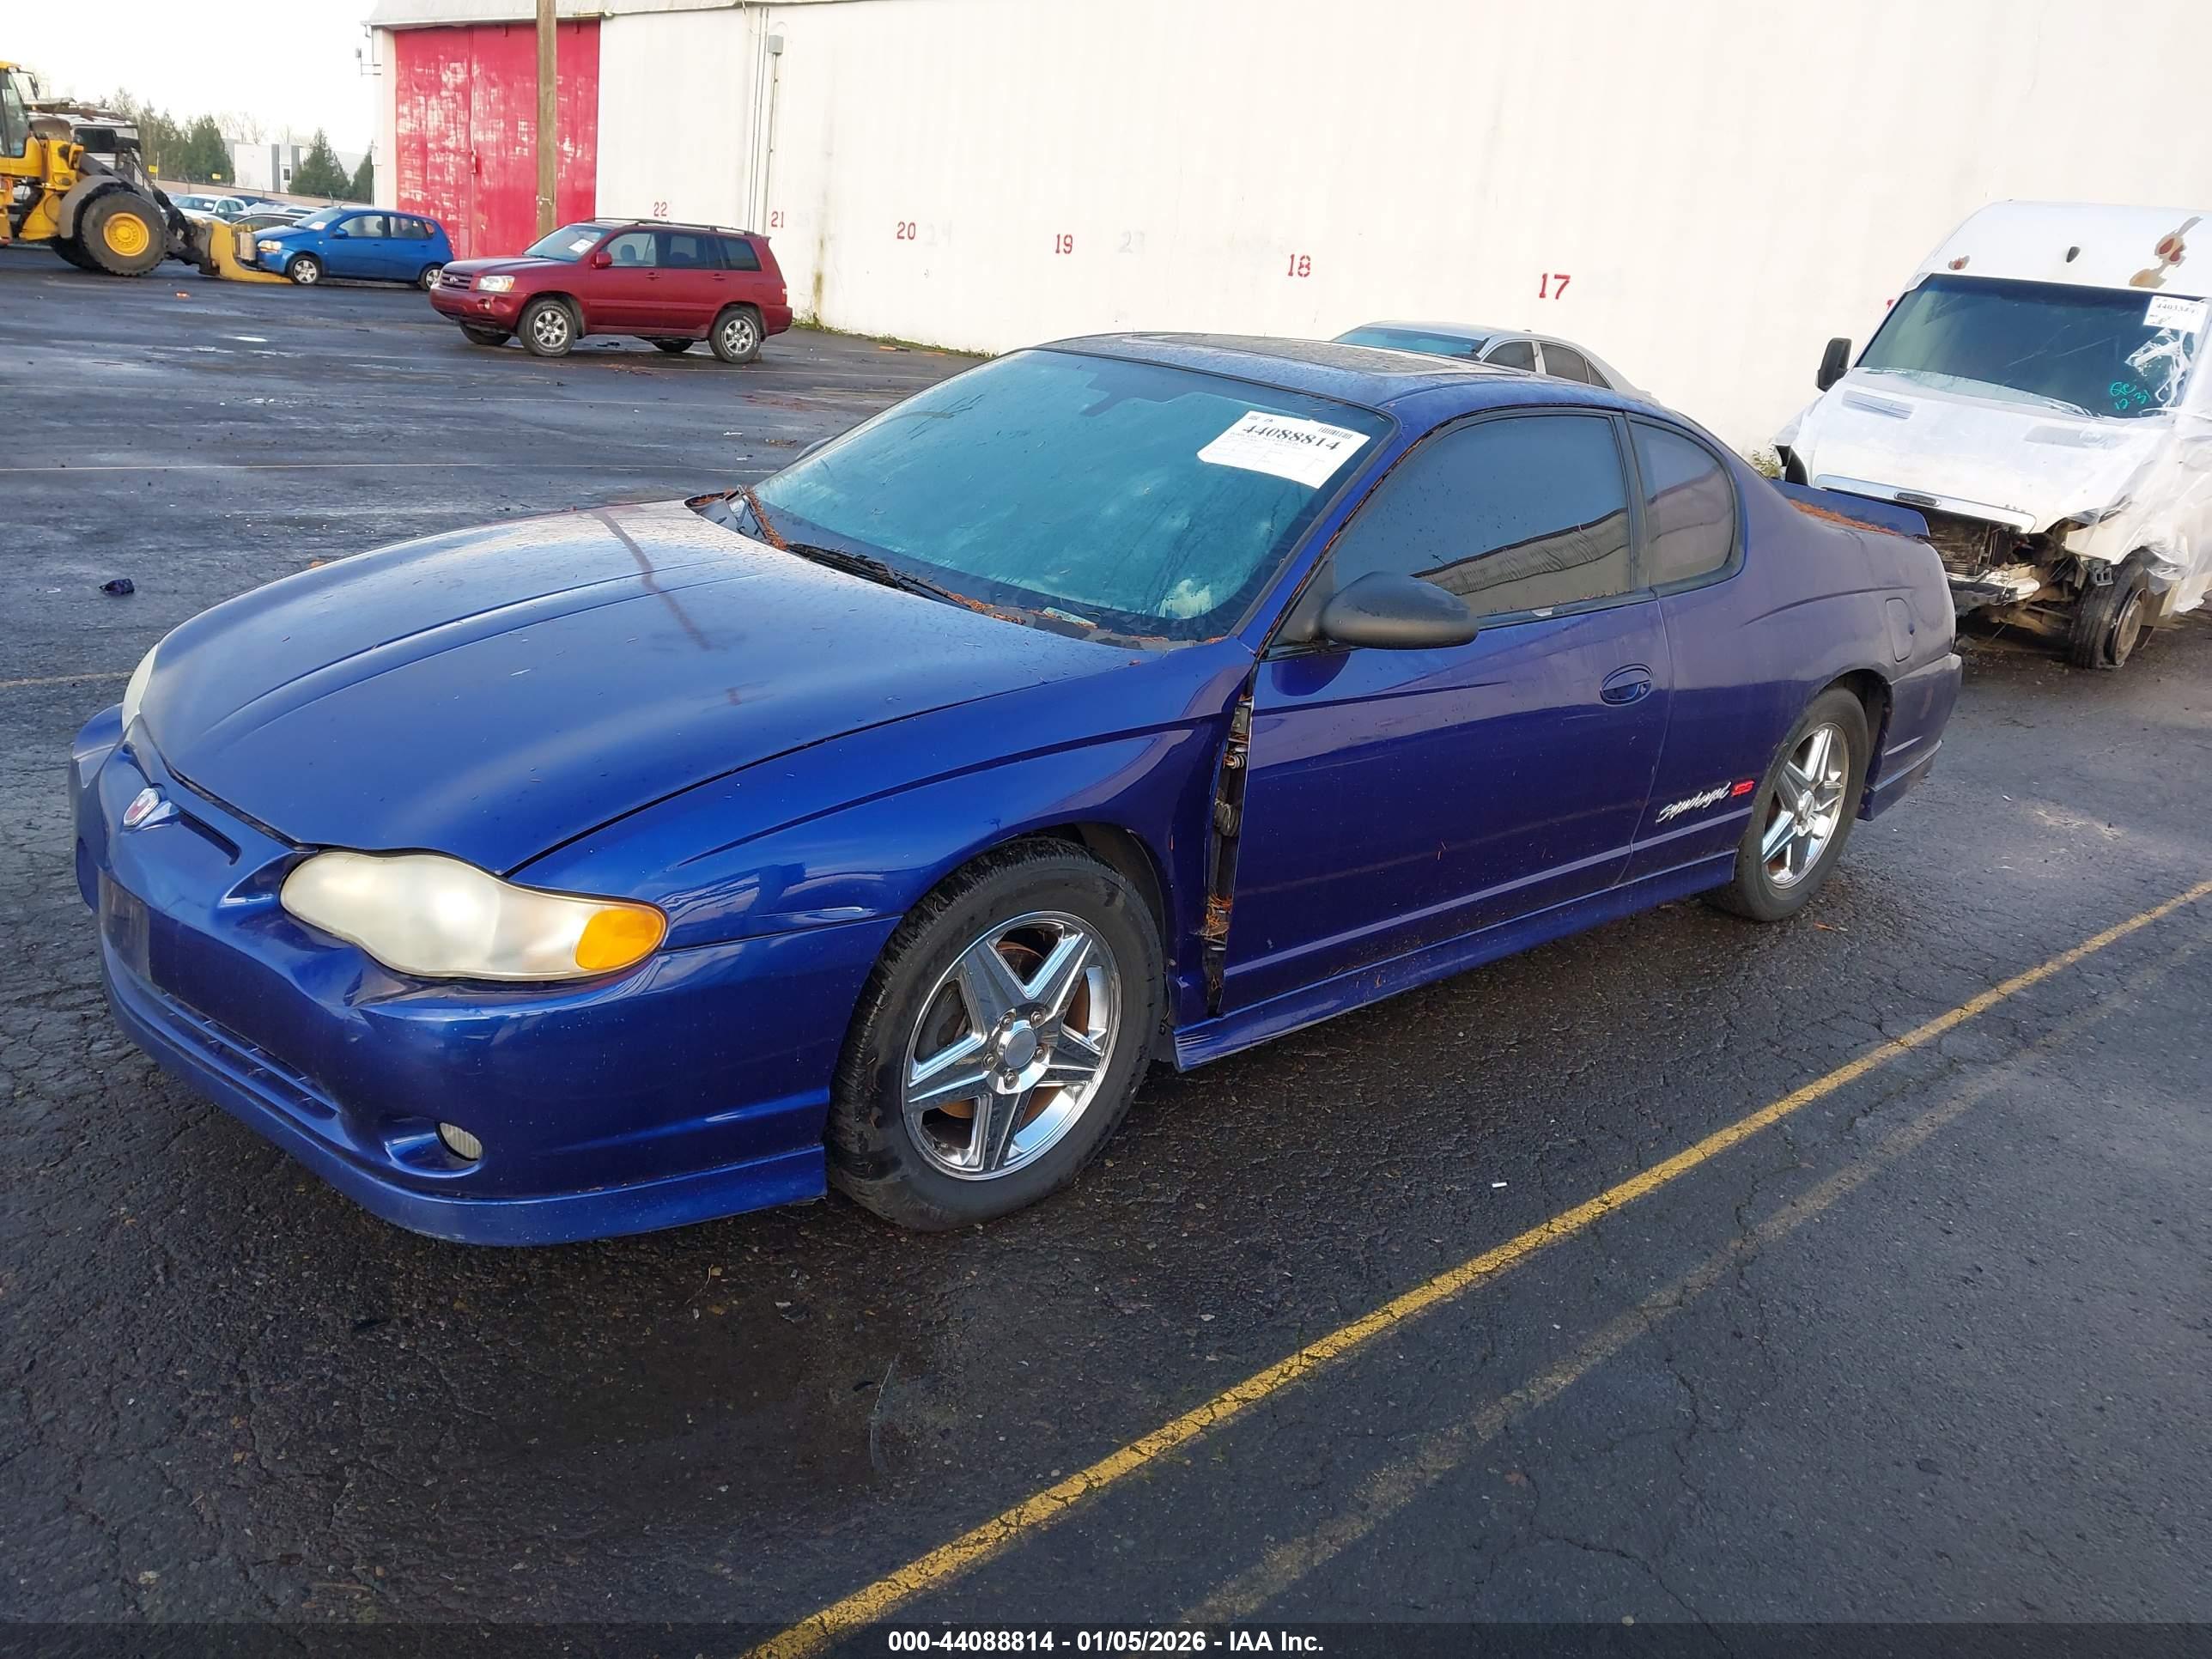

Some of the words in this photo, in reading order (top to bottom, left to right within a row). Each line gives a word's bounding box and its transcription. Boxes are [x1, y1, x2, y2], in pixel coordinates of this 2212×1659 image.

[653, 202, 667, 216] 22
[771, 211, 784, 228] 21
[897, 222, 916, 240] 20
[1055, 234, 1073, 254] 19
[1288, 254, 1311, 277] 18
[1539, 273, 1571, 300] 17
[1243, 424, 1341, 450] 44088814
